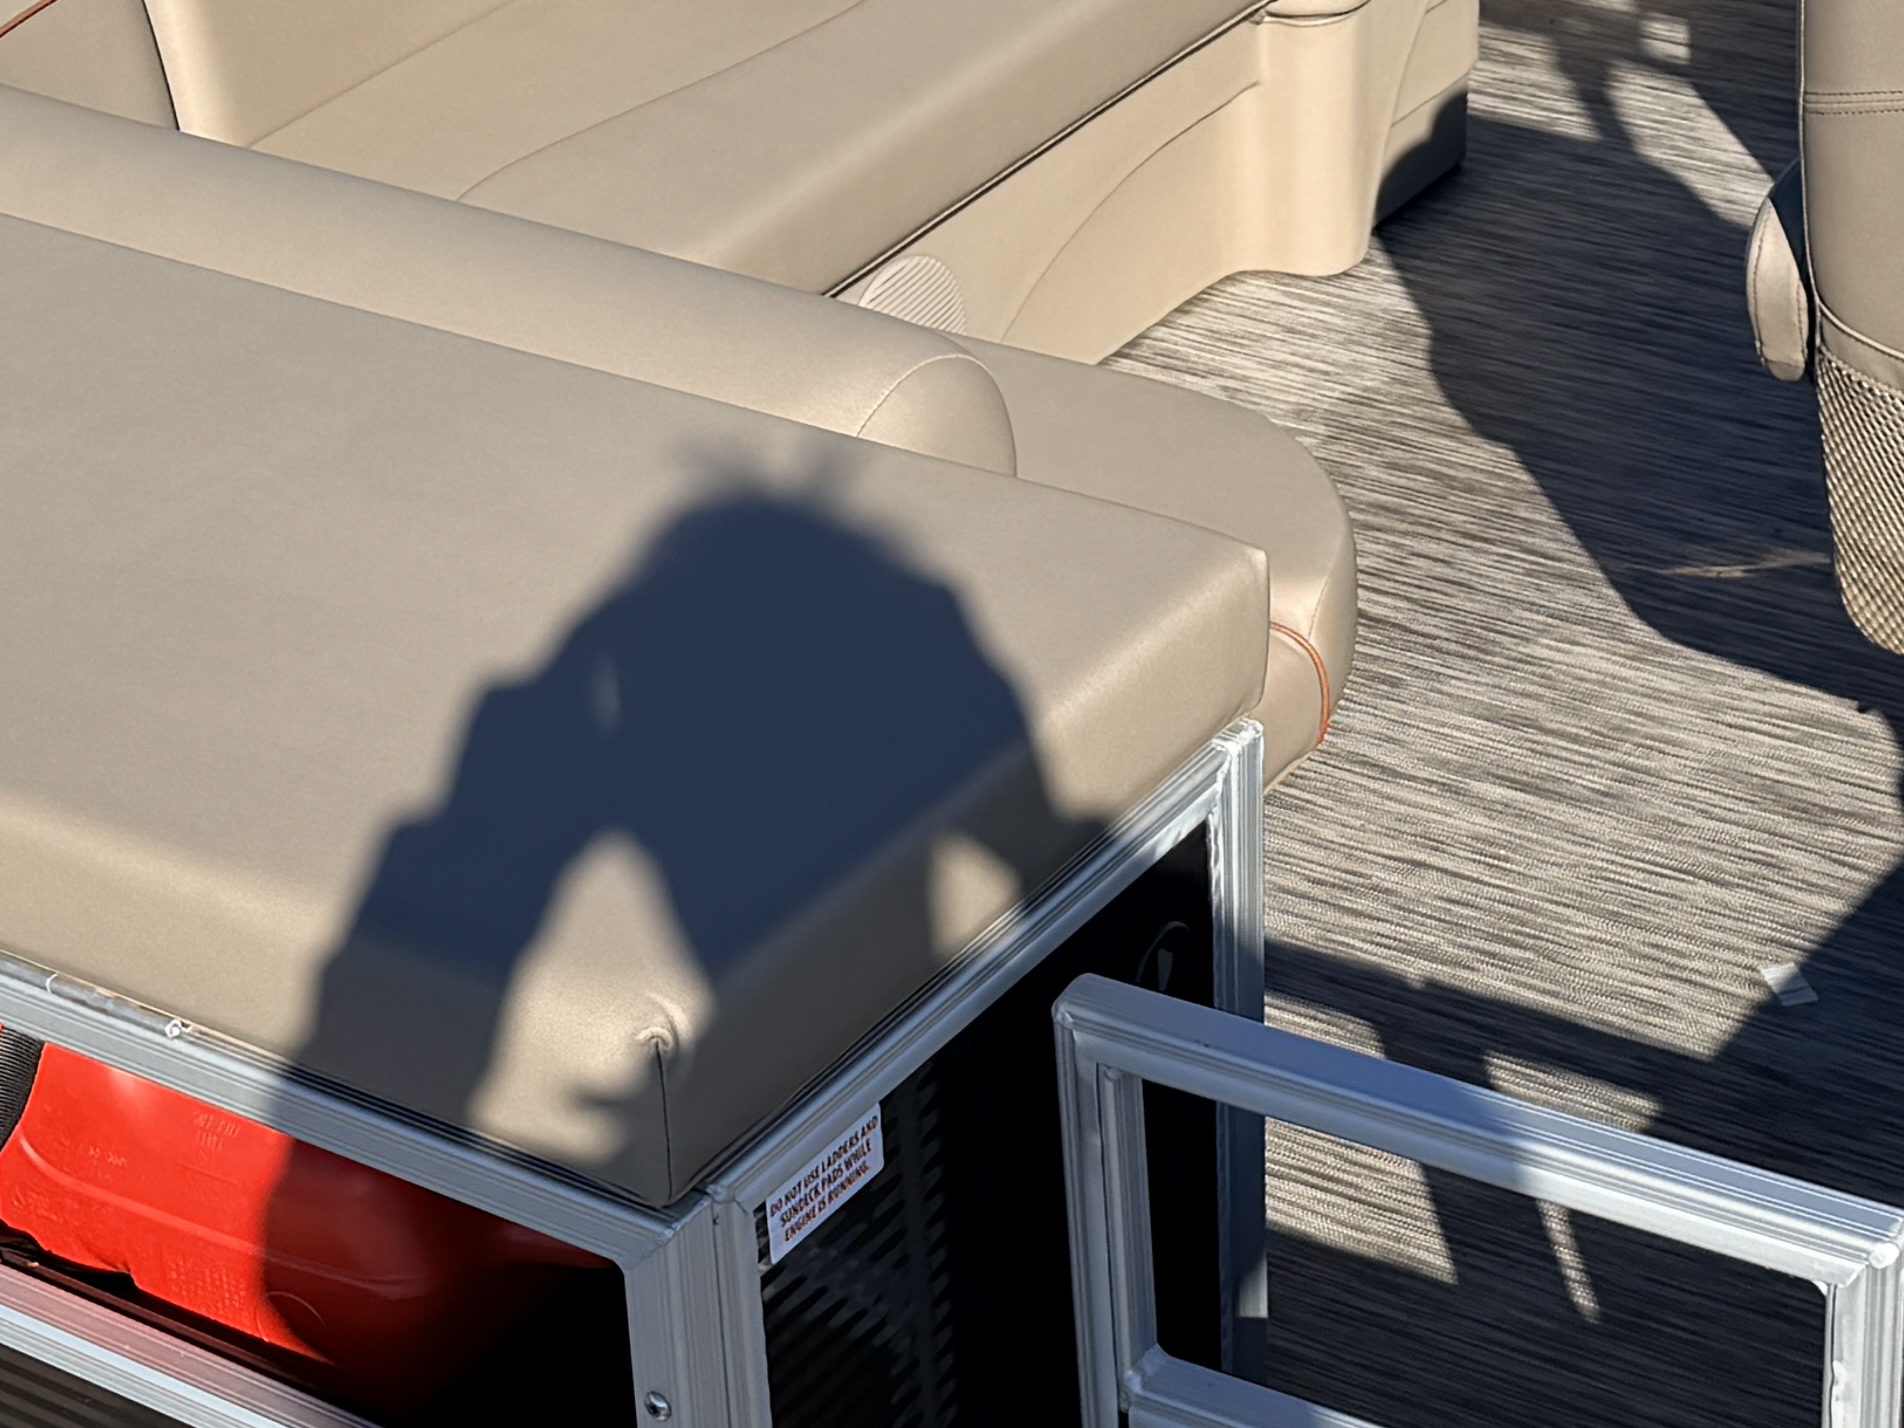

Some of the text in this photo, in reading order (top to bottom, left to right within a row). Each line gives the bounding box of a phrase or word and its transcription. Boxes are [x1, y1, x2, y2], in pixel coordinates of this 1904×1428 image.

[770, 1113, 878, 1217] DO NOT USE LADDERS AND
[779, 1136, 871, 1228] SUNDECK PADS WHILE
[784, 1203, 816, 1242] ENGINE
[817, 1195, 826, 1213] IS
